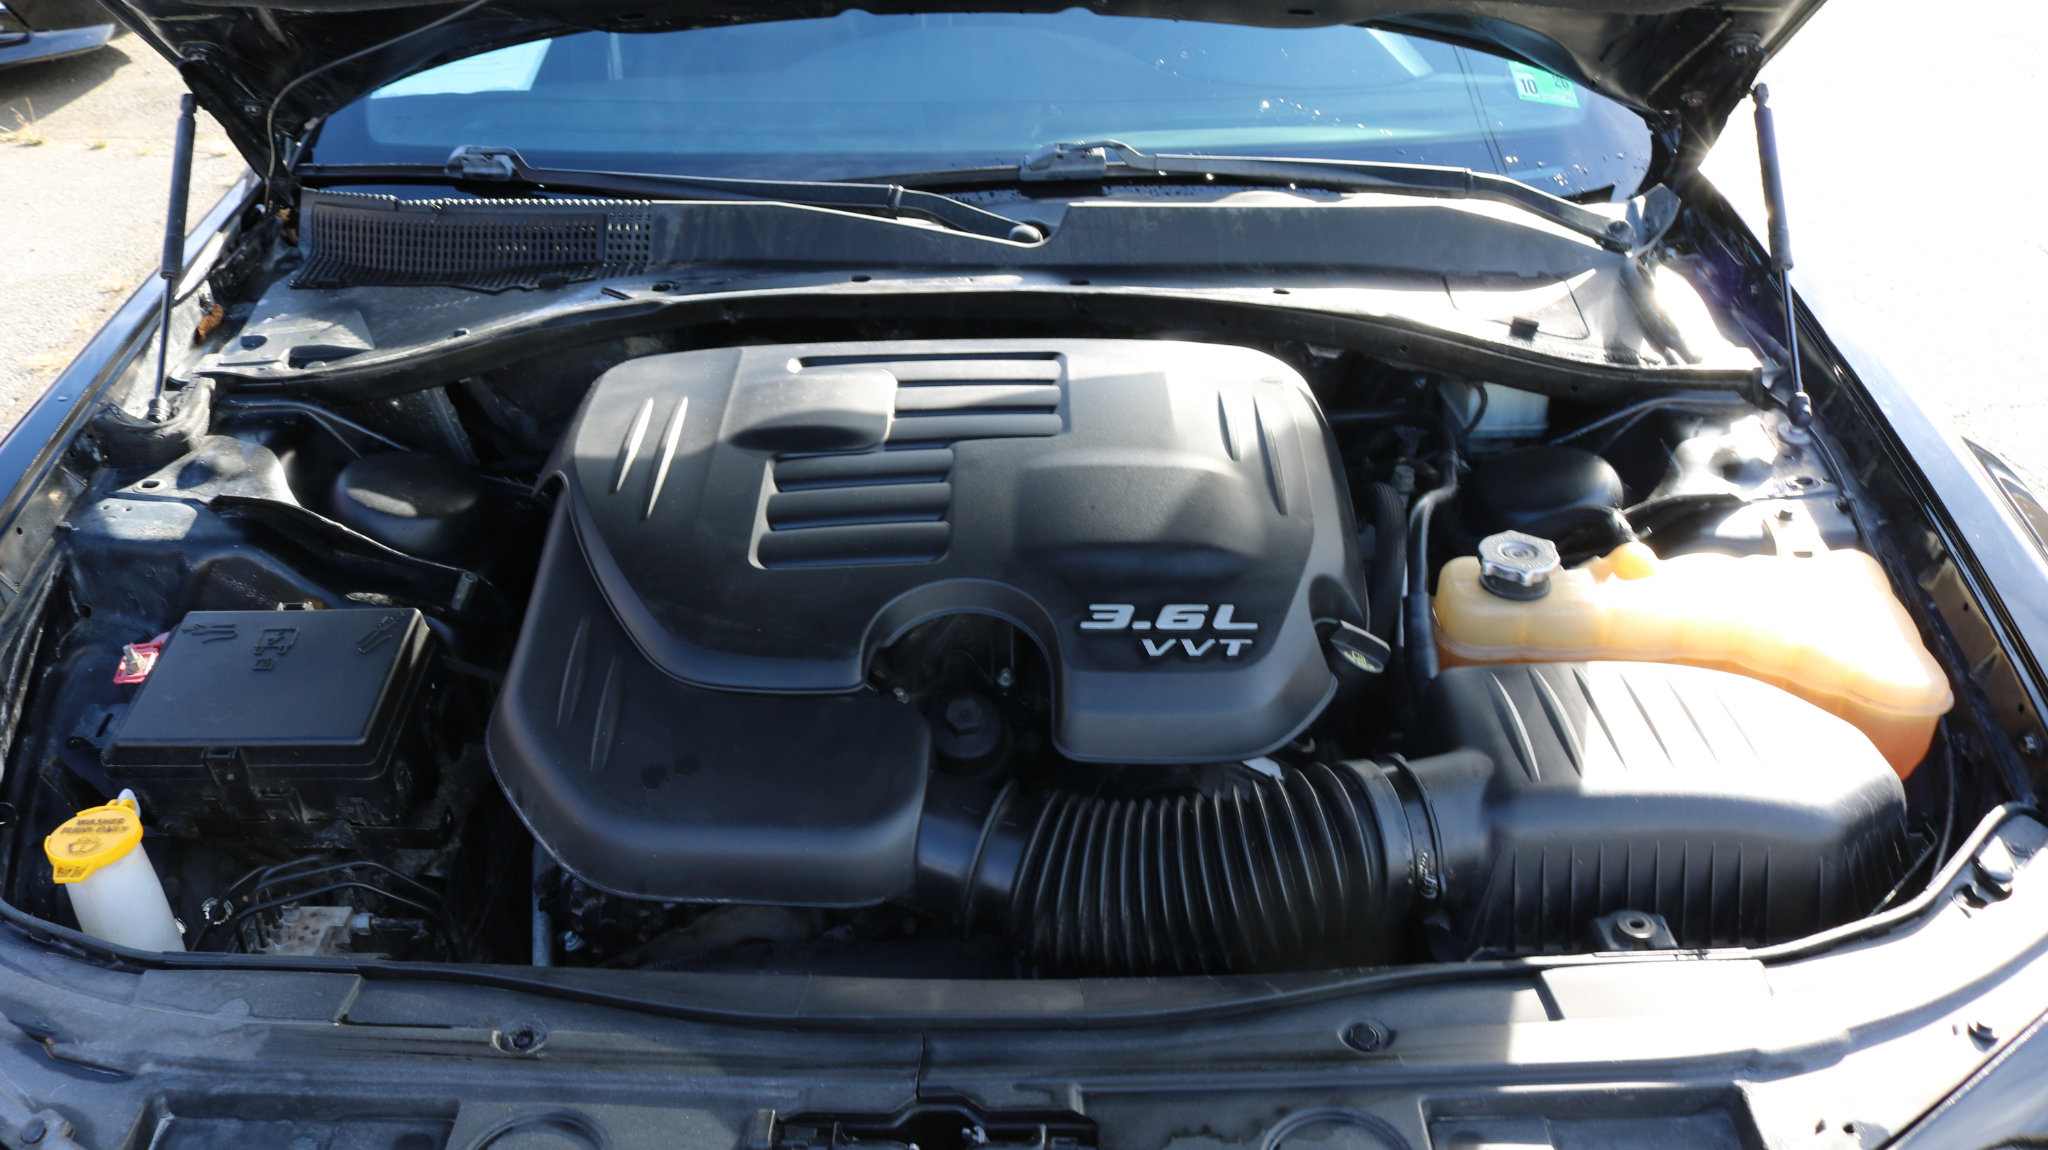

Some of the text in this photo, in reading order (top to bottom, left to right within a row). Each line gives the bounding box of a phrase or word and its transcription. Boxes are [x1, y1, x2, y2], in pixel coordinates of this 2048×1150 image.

[1519, 78, 1538, 94] 10
[1080, 603, 1259, 631] 3.6L
[1141, 638, 1254, 657] VVT
[76, 817, 126, 826] WASHER
